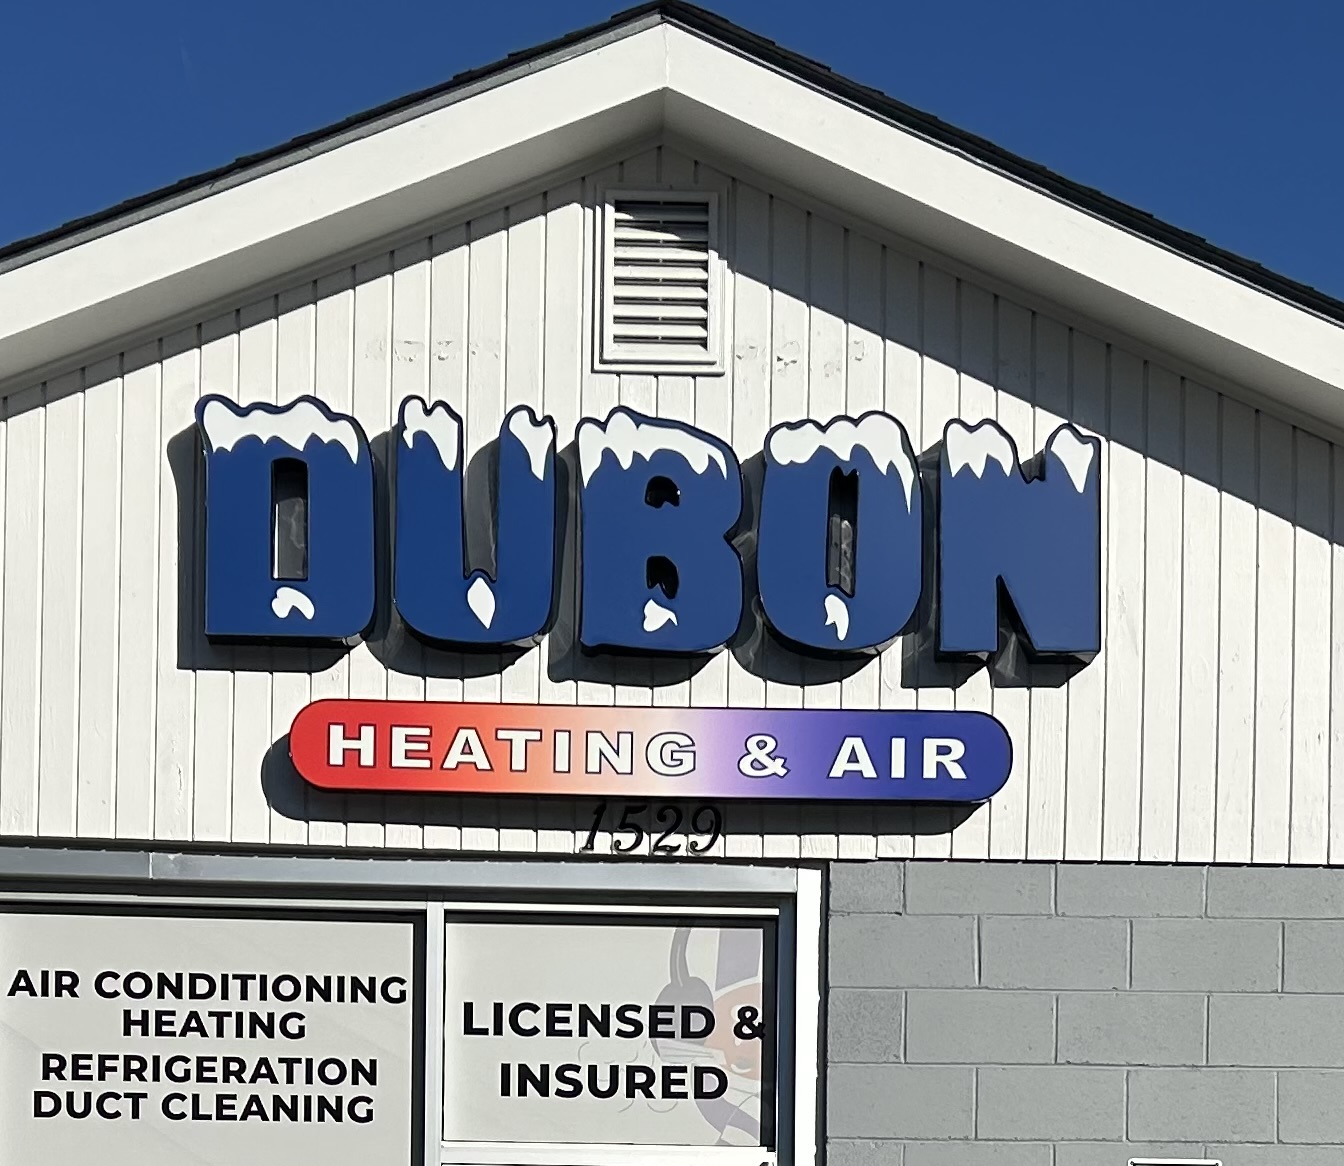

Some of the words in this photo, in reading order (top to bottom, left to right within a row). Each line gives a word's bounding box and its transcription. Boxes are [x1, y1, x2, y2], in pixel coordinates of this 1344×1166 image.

[195, 394, 1102, 660] DUBON
[326, 723, 698, 777] HEATING
[739, 734, 788, 778] &
[828, 736, 968, 781] AIR
[578, 802, 722, 855] 1529
[7, 970, 79, 998] AIR
[94, 970, 408, 1004] CONDITIONING
[122, 1009, 306, 1040] HEATING
[463, 1002, 716, 1040] LICENSED
[733, 1004, 767, 1041] &
[41, 1053, 378, 1086] REFRIGERATION
[500, 1062, 729, 1100] INSURED
[33, 1090, 147, 1120] DUCT
[161, 1092, 374, 1124] CLEANING
